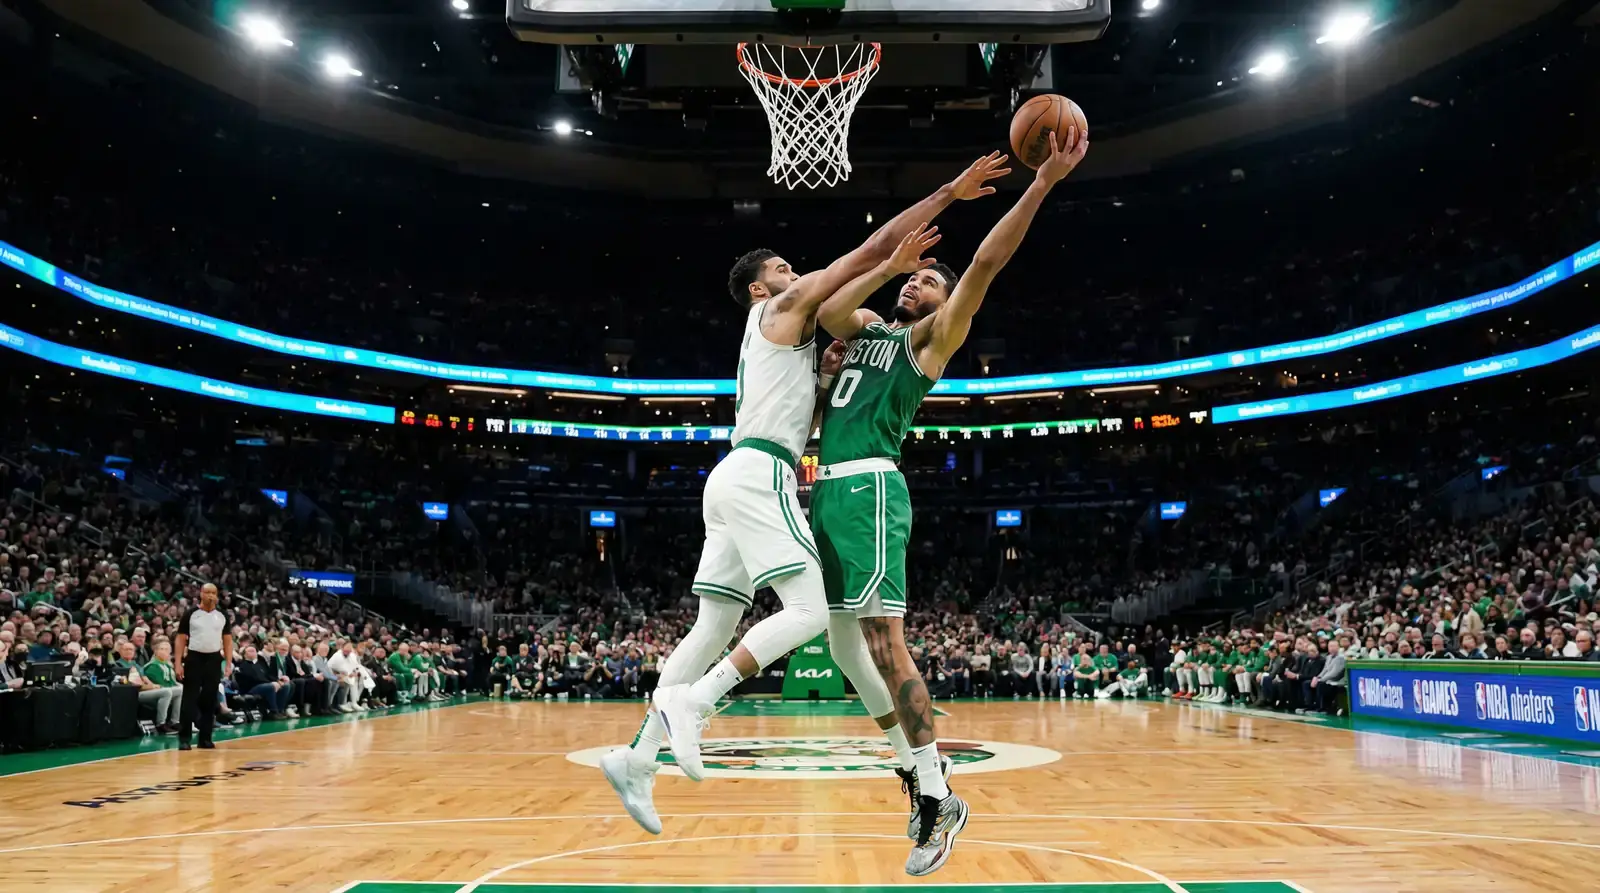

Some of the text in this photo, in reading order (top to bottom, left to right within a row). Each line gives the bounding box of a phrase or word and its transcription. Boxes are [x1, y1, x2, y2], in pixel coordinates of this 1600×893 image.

[841, 339, 900, 373] OSTON
[831, 368, 863, 408] 0
[1421, 680, 1459, 717] GAMES
[1485, 683, 1510, 721] NBA
